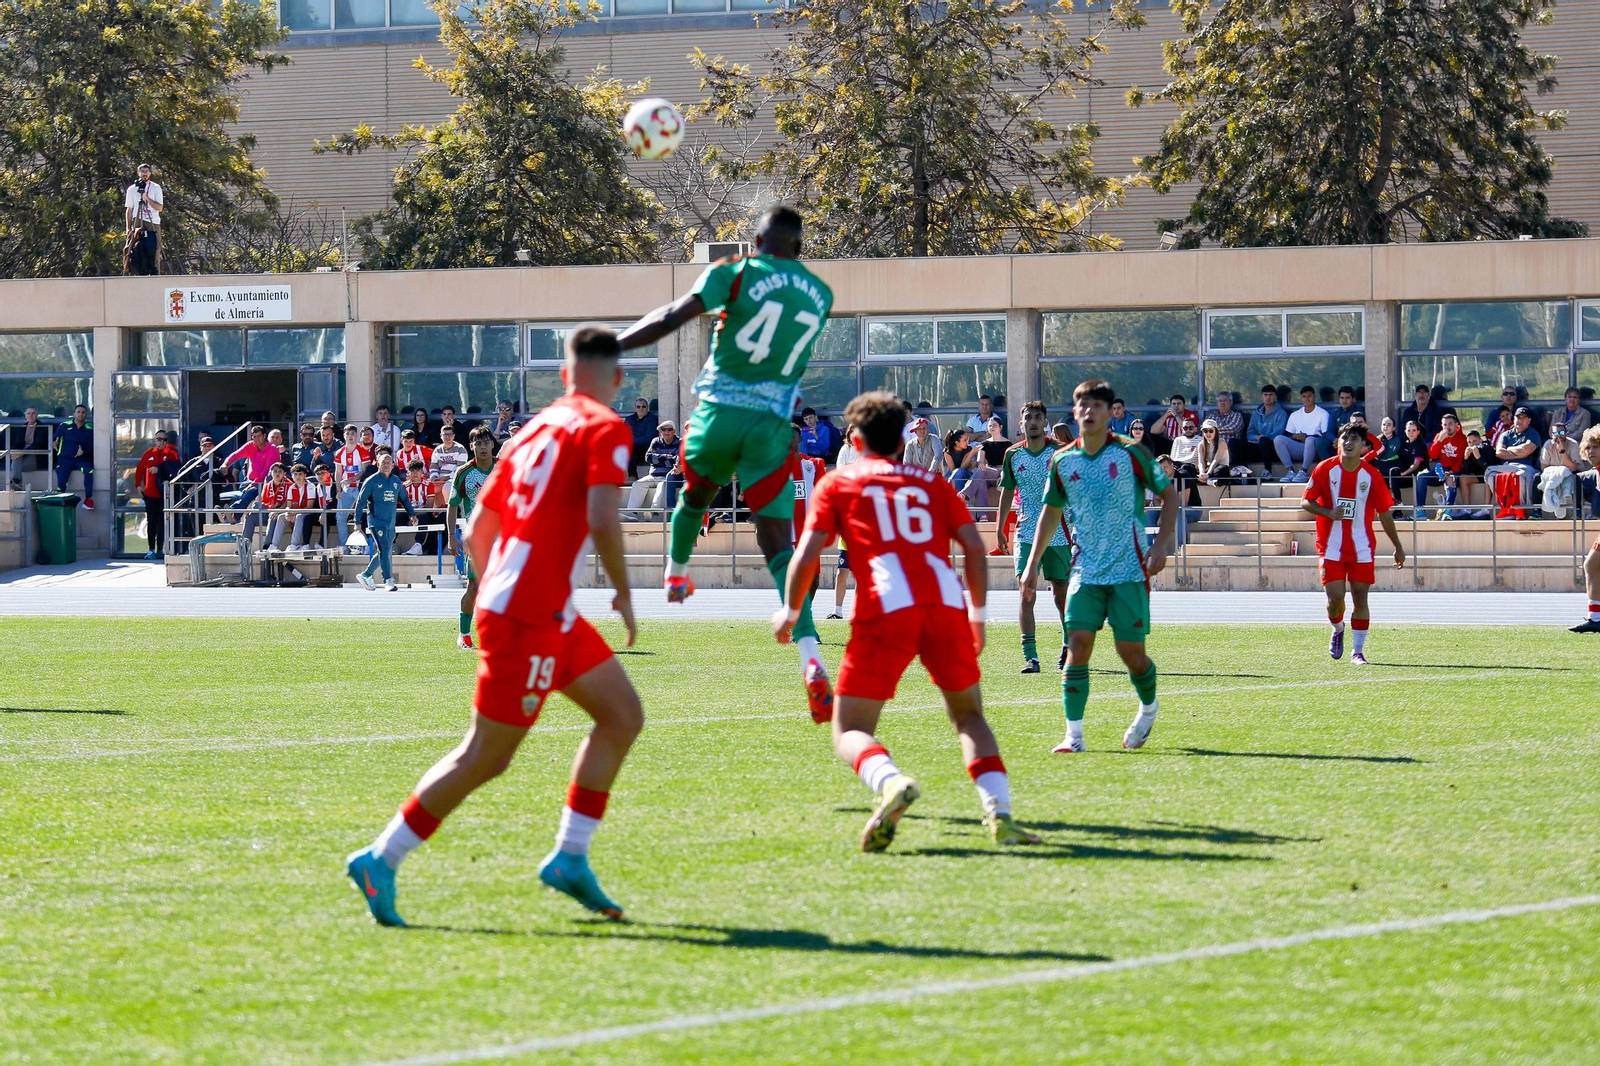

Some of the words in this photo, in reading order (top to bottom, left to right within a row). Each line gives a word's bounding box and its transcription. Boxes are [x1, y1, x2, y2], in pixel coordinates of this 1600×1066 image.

[190, 291, 223, 303] Excmo.
[225, 289, 289, 304] Ayuntamiento
[215, 308, 226, 319] de
[228, 307, 264, 319] Almería
[734, 299, 821, 377] 47
[861, 485, 934, 544] 16
[525, 654, 556, 690] 19
